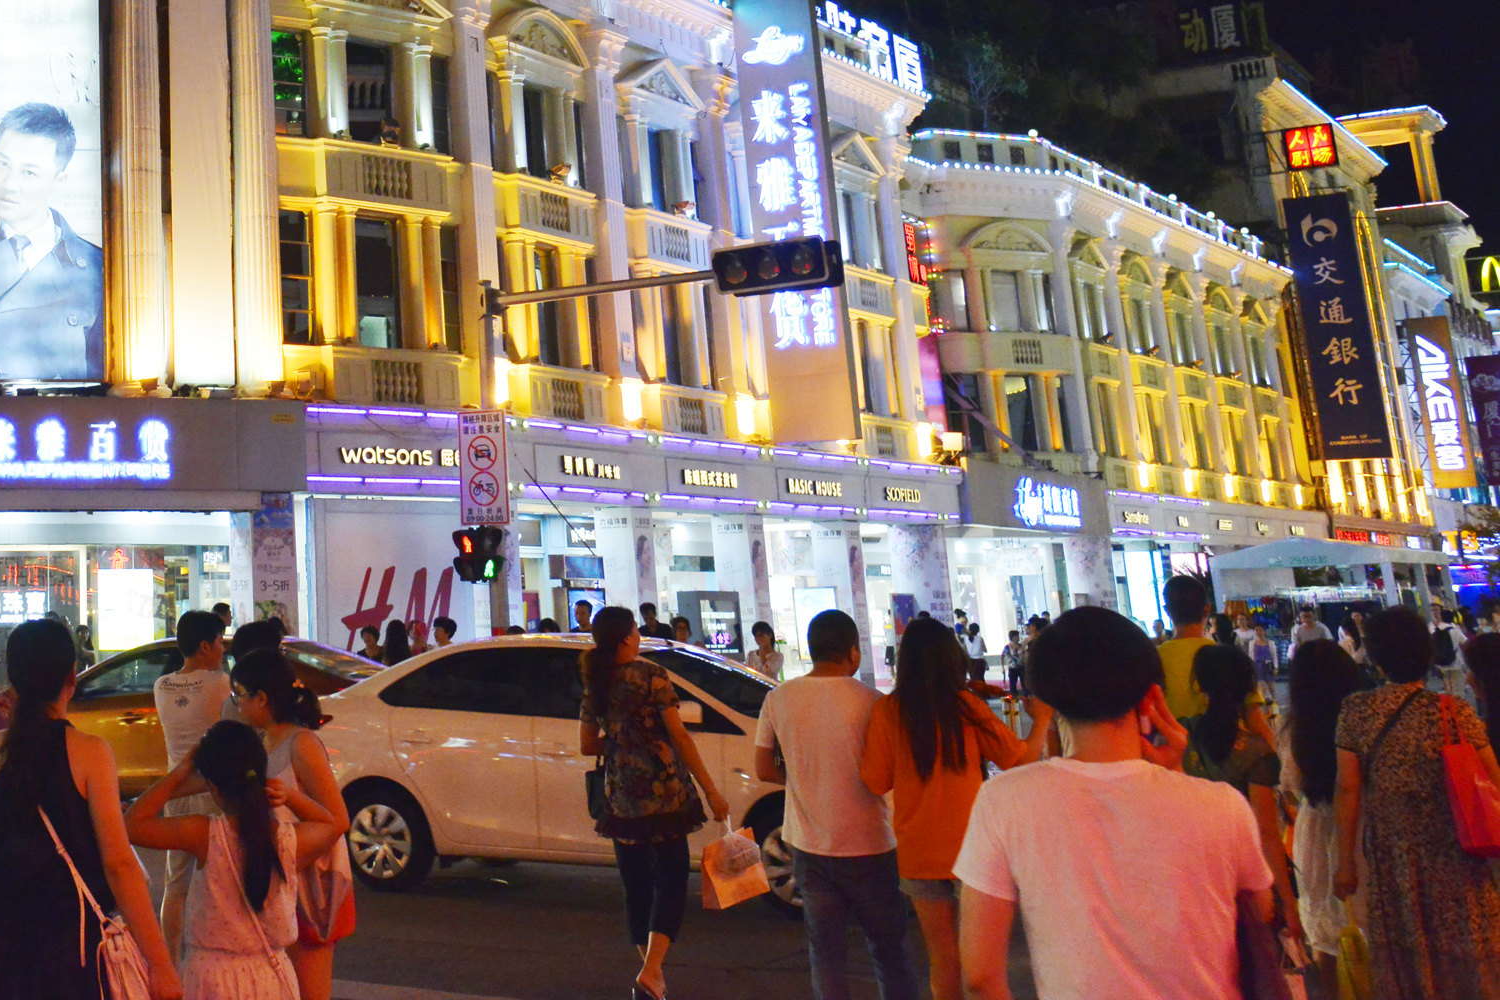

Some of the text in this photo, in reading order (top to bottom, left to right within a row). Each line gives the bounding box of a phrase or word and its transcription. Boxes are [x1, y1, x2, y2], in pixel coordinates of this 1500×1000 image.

[1312, 257, 1363, 405] 交通銀行
[341, 446, 433, 466] watsons
[788, 478, 842, 497] BASIC HOUSE
[887, 487, 921, 503] SCOFIELD
[260, 581, 290, 591] 3-5折
